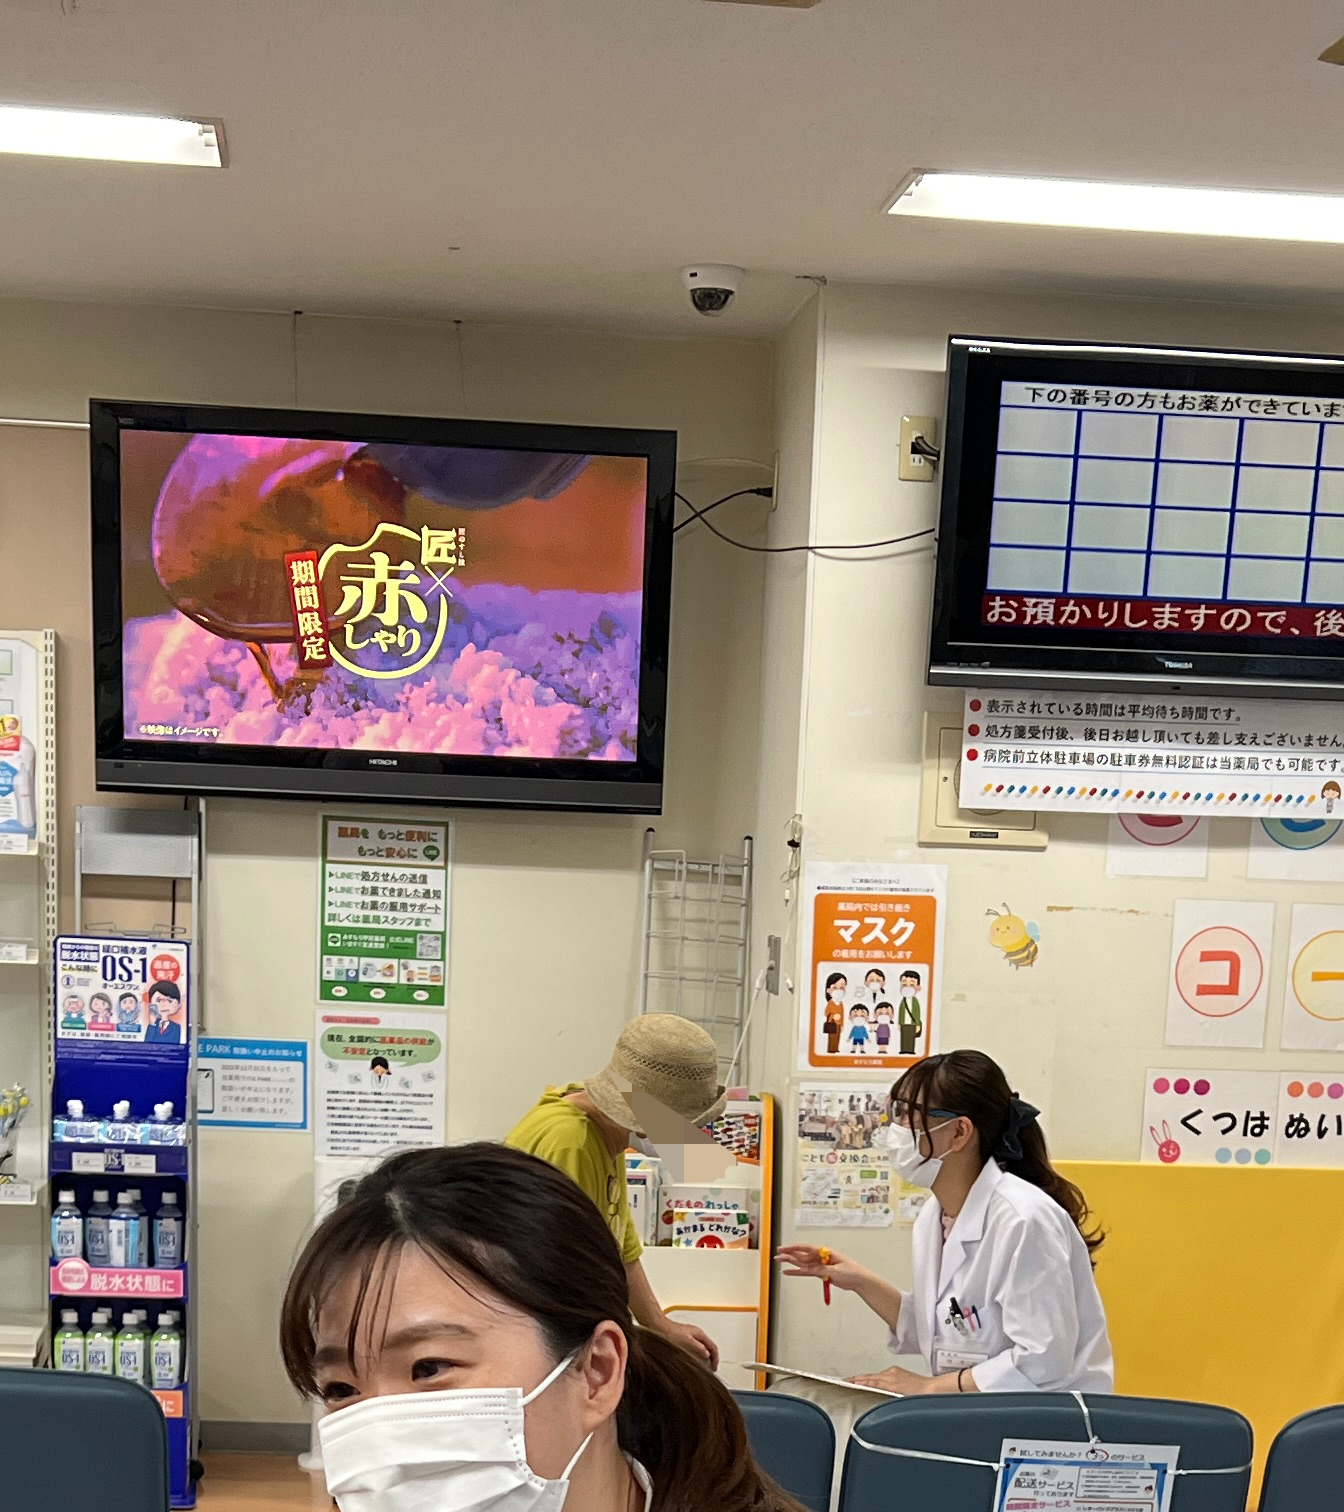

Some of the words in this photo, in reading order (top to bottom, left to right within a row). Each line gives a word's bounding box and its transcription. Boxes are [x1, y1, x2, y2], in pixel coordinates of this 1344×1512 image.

[420, 525, 457, 566] 匠
[333, 551, 428, 626] 赤
[289, 560, 327, 661] 期間限定
[344, 623, 421, 657] しゃり
[986, 699, 1243, 723] 表示されている時間は平均待ち時間です。
[833, 916, 916, 947] マスク
[102, 955, 147, 983] OS-1
[1179, 1107, 1270, 1139] くつは
[90, 1273, 175, 1293] 脱水状態に
[1014, 1478, 1074, 1490] 配送サービス
